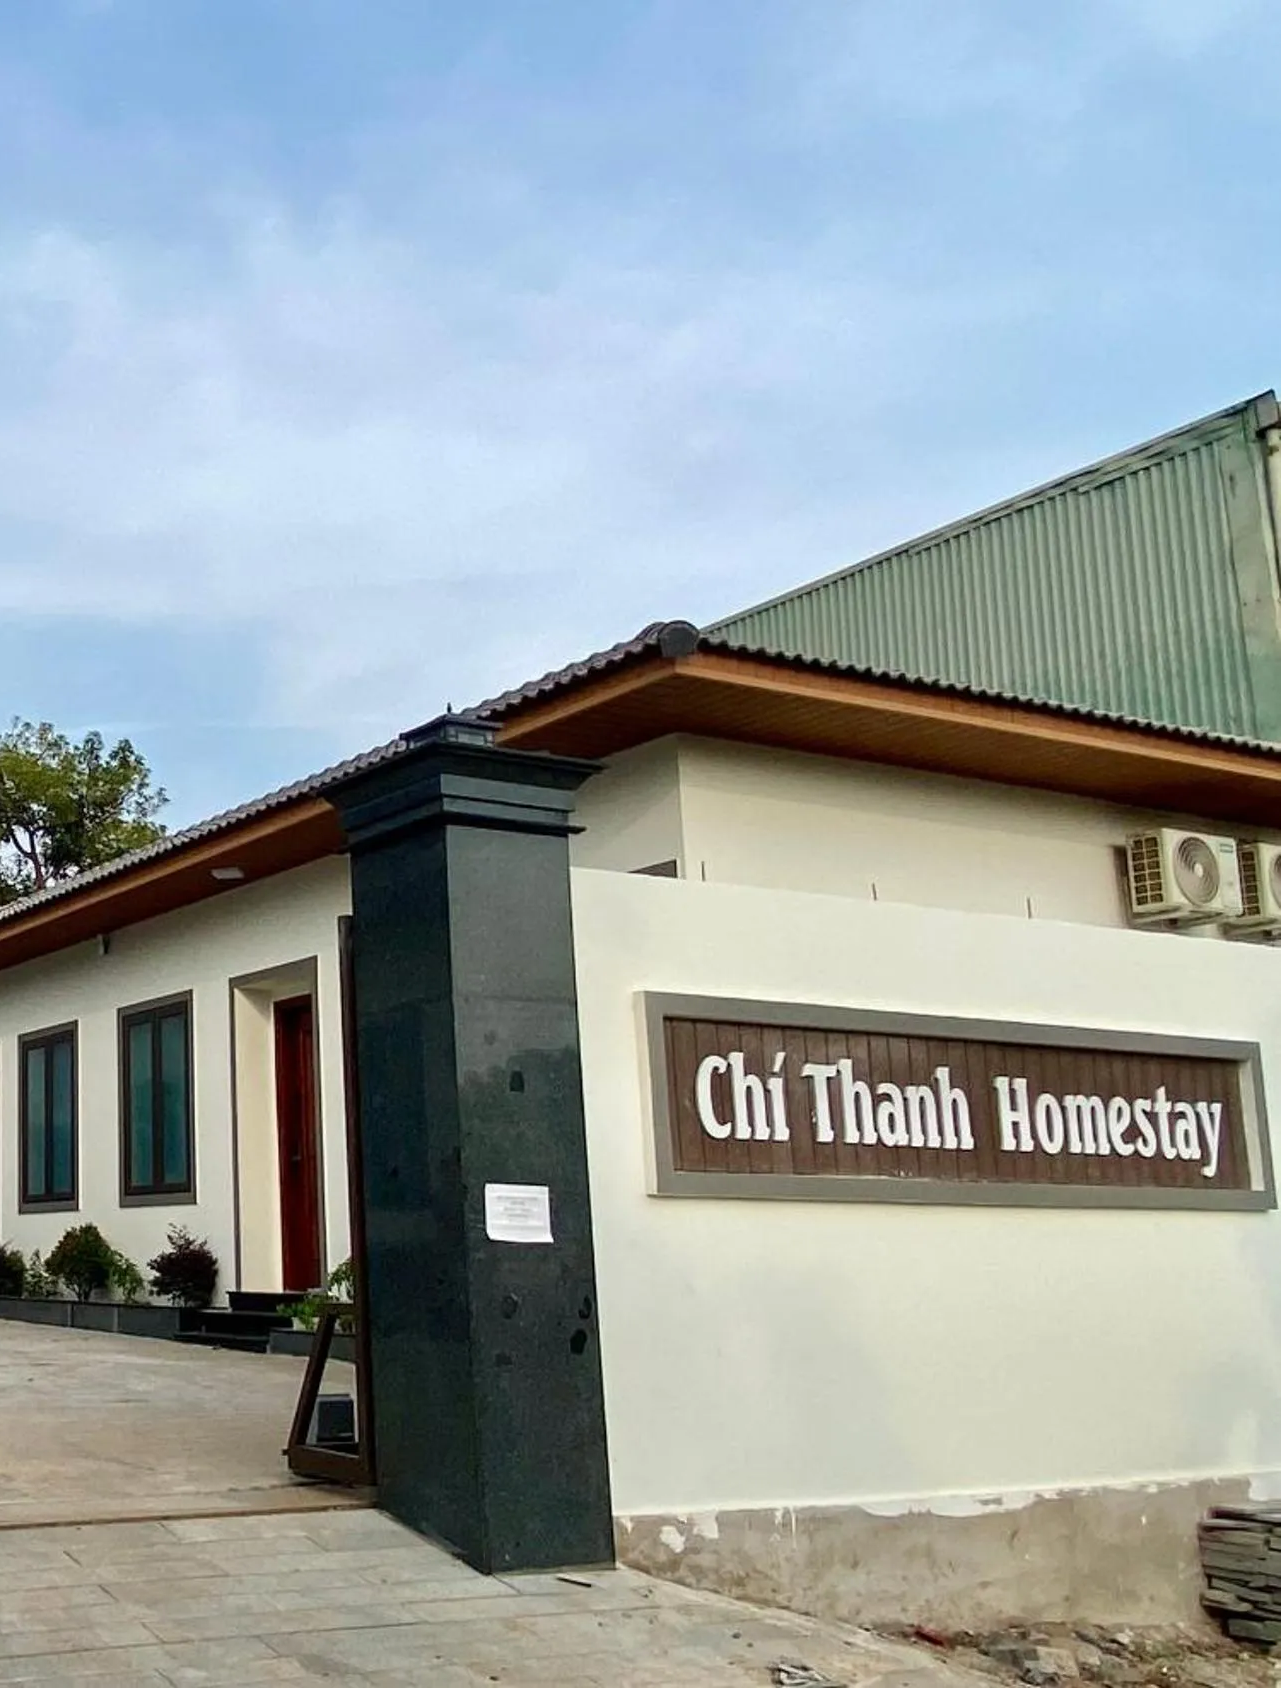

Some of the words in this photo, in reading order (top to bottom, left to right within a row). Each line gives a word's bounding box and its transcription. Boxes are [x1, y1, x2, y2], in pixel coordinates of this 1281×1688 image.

[695, 1051, 790, 1141] Chí
[800, 1058, 975, 1150] Thanh
[993, 1075, 1223, 1178] Homestay
